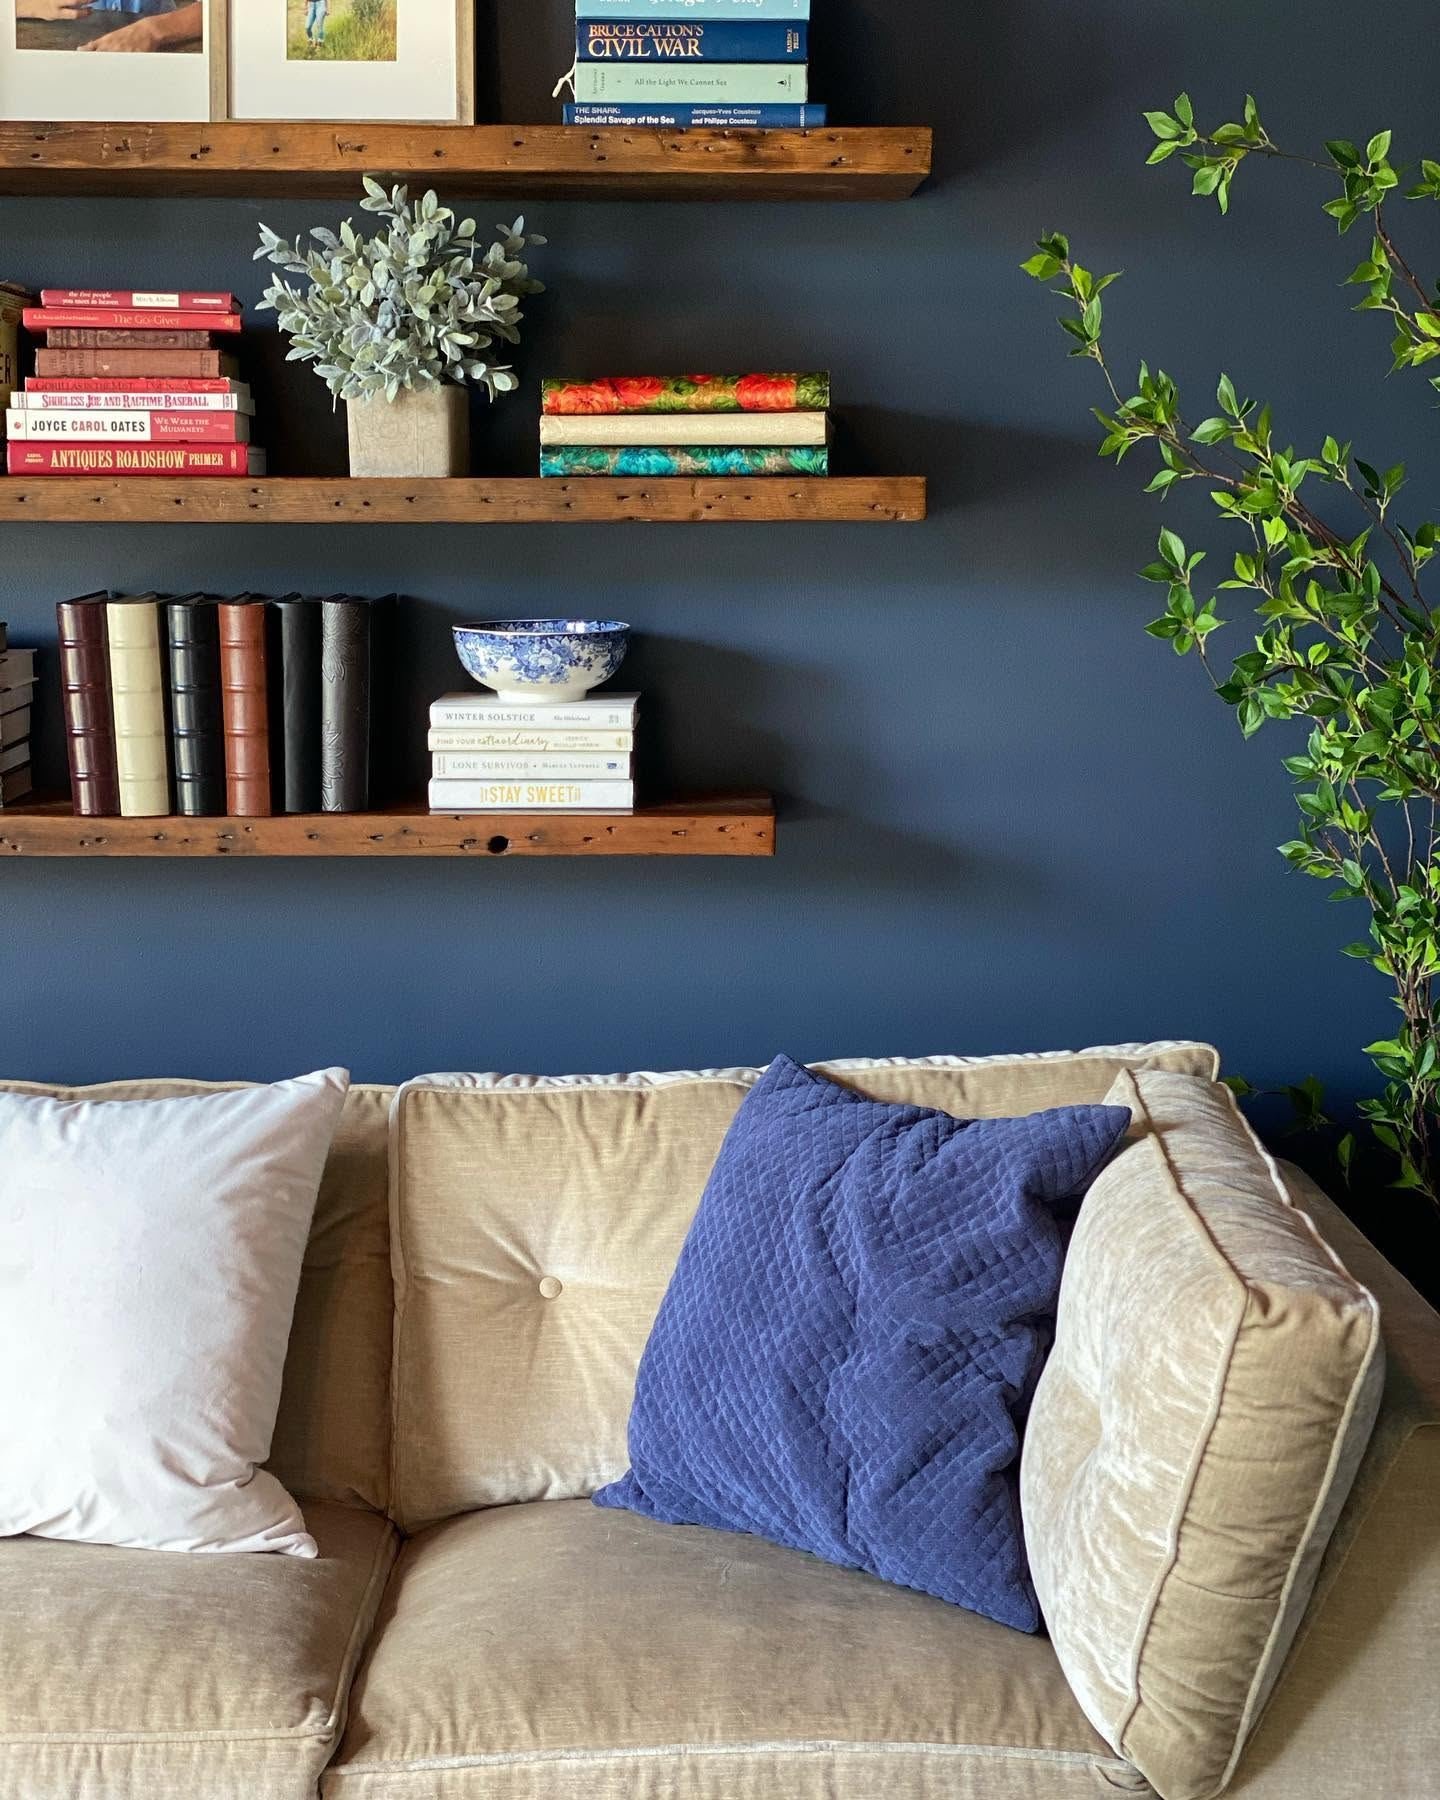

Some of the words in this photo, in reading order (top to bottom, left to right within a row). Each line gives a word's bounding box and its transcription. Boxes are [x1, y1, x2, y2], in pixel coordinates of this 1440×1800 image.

[588, 24, 635, 37] BRUCE
[636, 24, 704, 37] CATTON'S
[588, 38, 651, 57] CIVIL
[652, 38, 704, 57] WAR
[658, 79, 676, 87] Light
[574, 115, 609, 125] Splendid
[609, 116, 636, 125] Savage
[637, 116, 645, 124] of
[645, 116, 659, 124] the
[659, 116, 675, 124] Sea
[113, 313, 132, 324] The
[32, 420, 67, 431] JOYCE
[71, 420, 107, 432] CAROL
[111, 421, 145, 432] OATES
[50, 449, 113, 470] ANTIQUES
[115, 449, 185, 468] ROADSHOW
[189, 453, 224, 465] PRIMER
[445, 712, 485, 720] WINTER
[487, 713, 536, 721] SOLSTICE
[489, 786, 521, 802] STAY
[527, 786, 575, 802] SWEET
